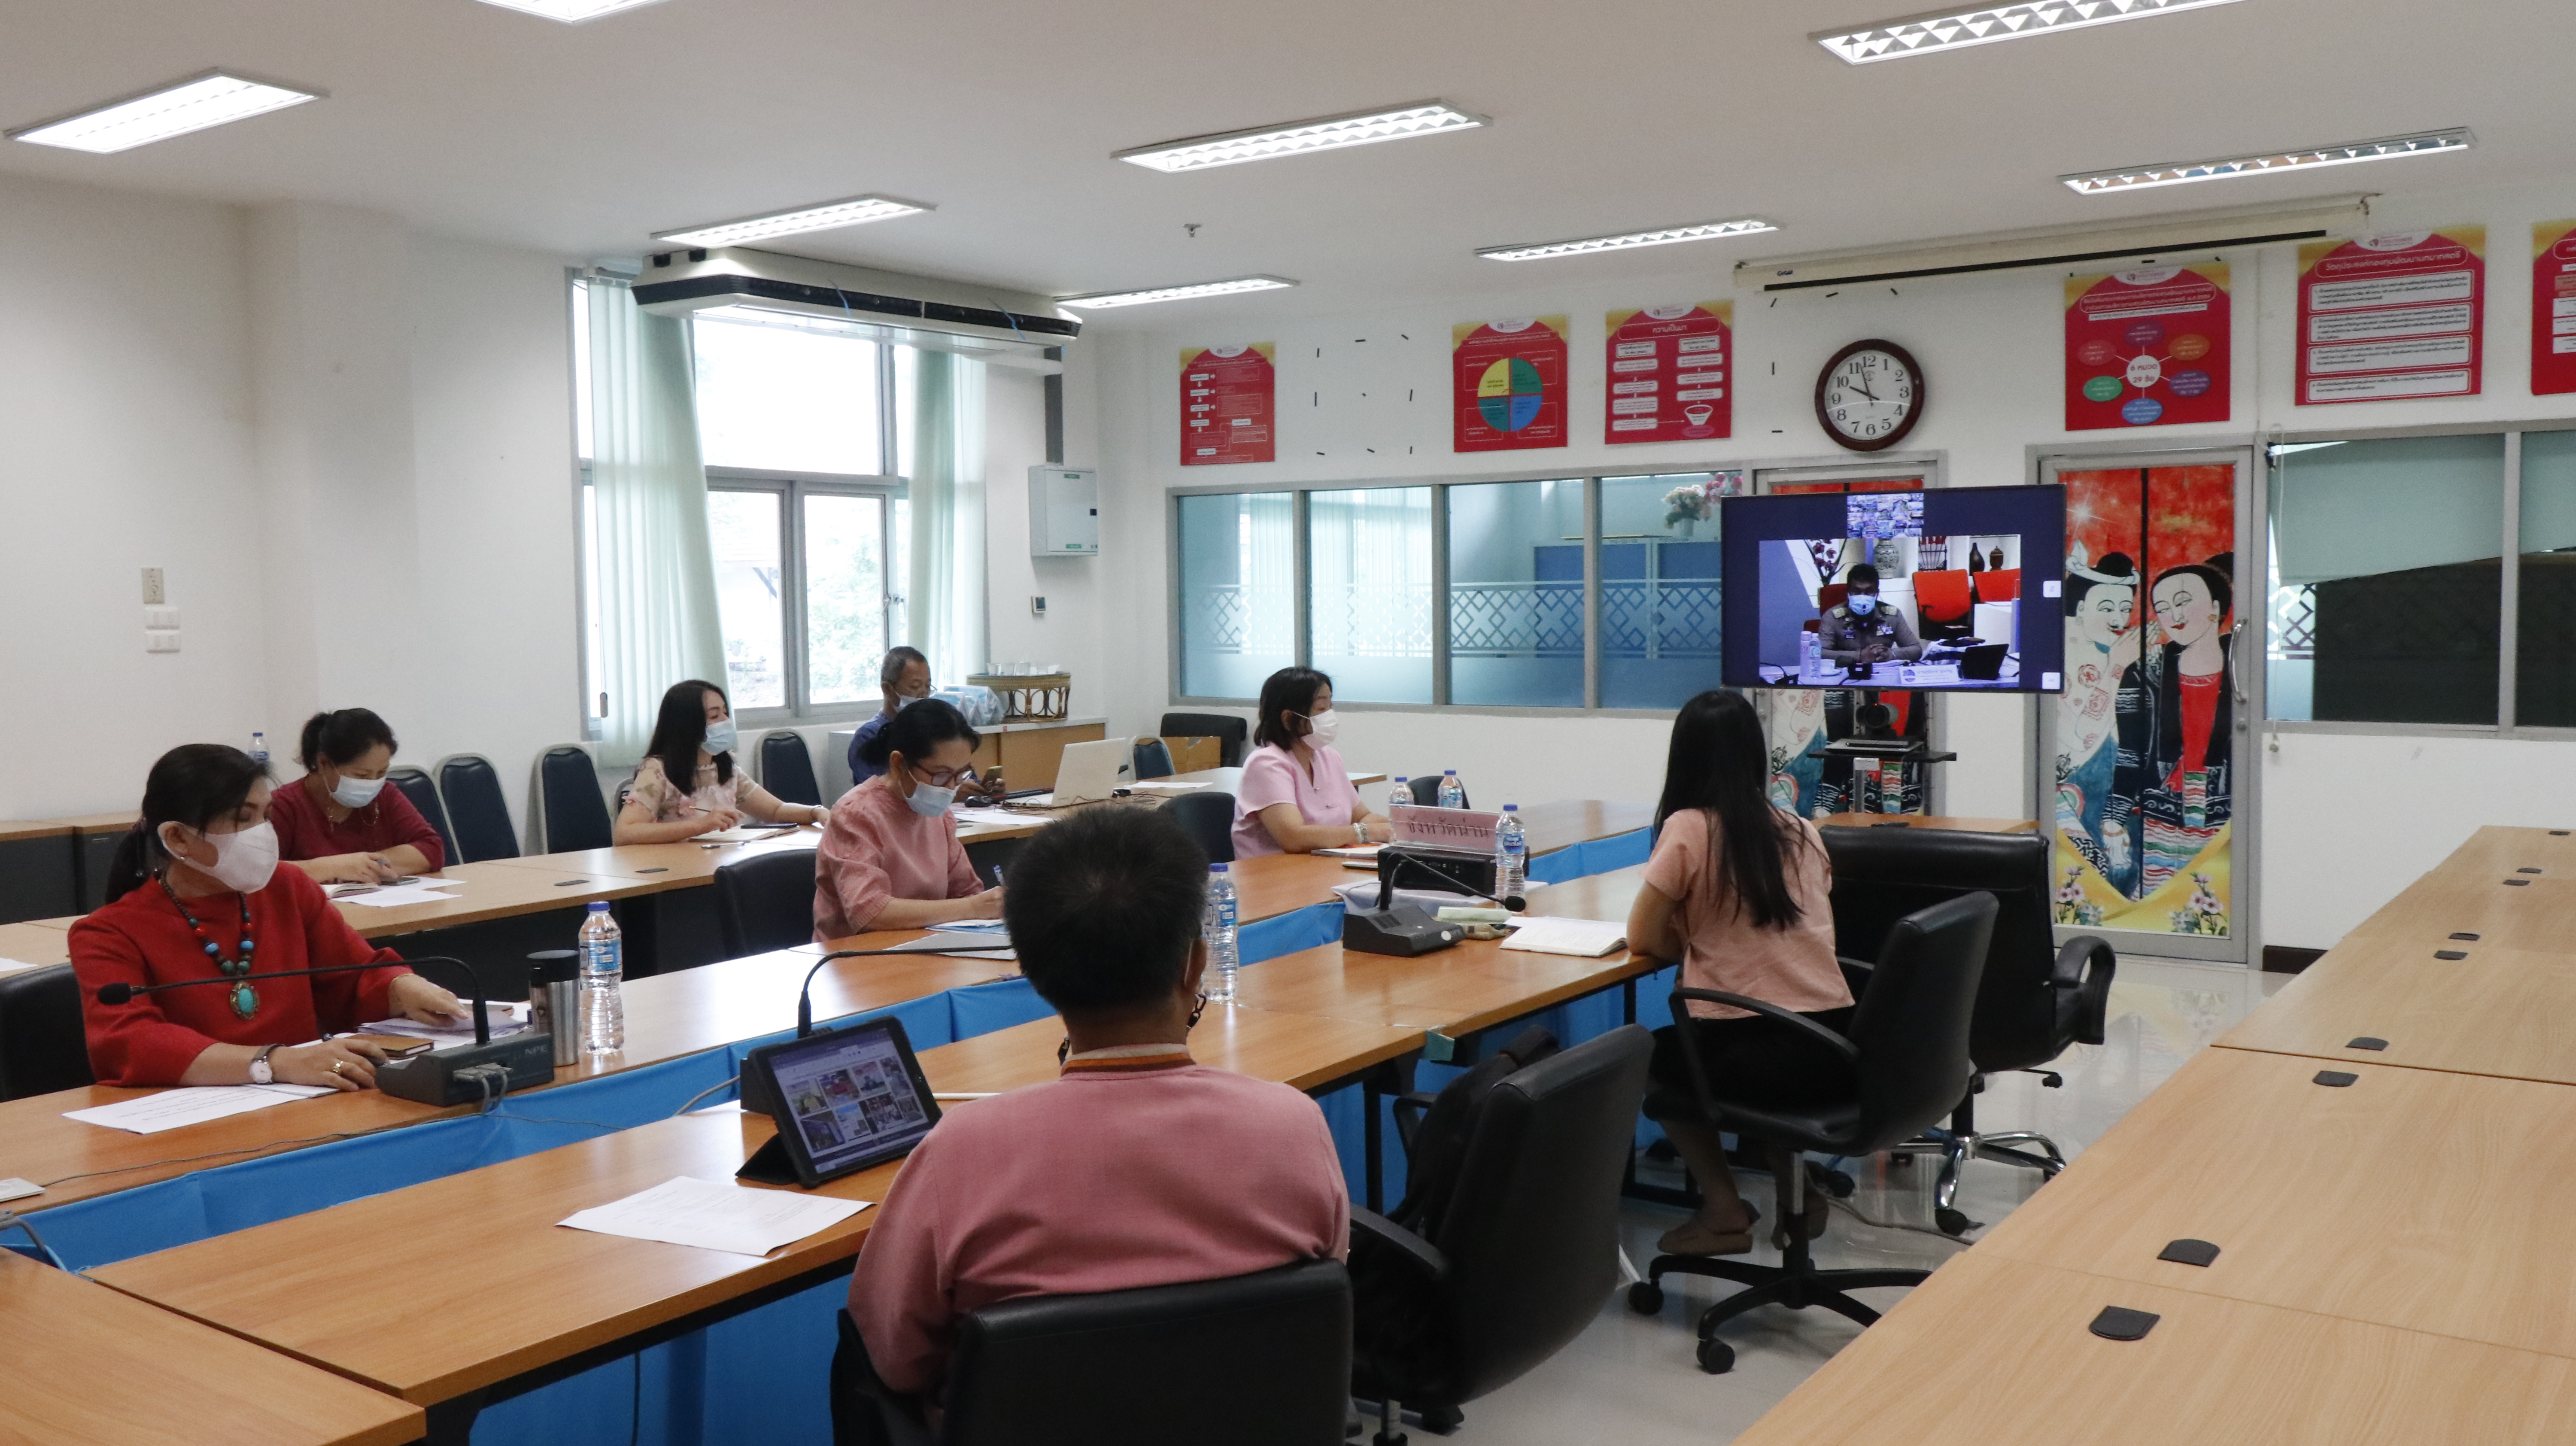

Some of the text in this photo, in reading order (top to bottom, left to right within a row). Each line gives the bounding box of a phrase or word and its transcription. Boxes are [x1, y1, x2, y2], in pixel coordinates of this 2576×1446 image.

[1863, 355, 1876, 367] 12
[1883, 358, 1888, 370] 1
[1849, 362, 1859, 374] 11
[1836, 376, 1849, 388] 10
[1895, 370, 1903, 382] 2
[1899, 386, 1909, 398] 3
[1832, 393, 1841, 404] 9
[1837, 409, 1847, 420] 8
[1893, 404, 1902, 416] 4
[1851, 421, 1860, 433] 7
[1866, 424, 1876, 435] 6
[1882, 418, 1891, 430] 5
[1406, 815, 1489, 838] จังหวัดน่าน
[525, 1045, 548, 1055] NPE
